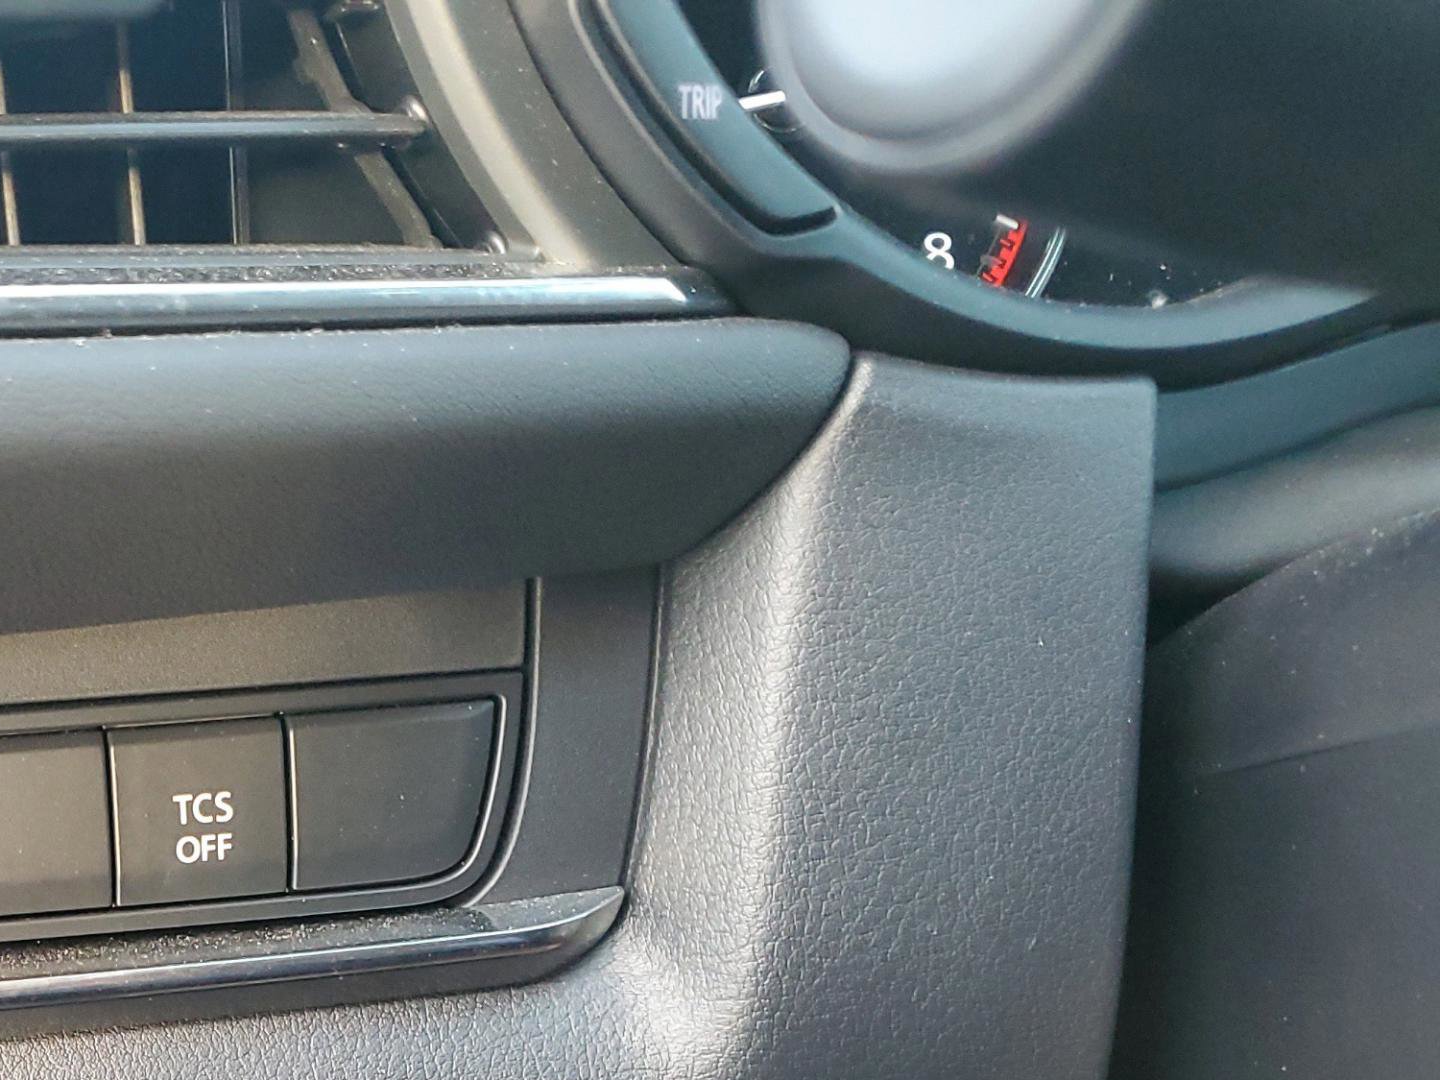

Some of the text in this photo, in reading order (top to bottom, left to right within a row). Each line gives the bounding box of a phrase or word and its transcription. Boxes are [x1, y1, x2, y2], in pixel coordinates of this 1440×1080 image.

[677, 84, 722, 120] TRIP
[923, 231, 955, 270] 8
[172, 790, 234, 825] TCS
[176, 832, 233, 864] OFF
